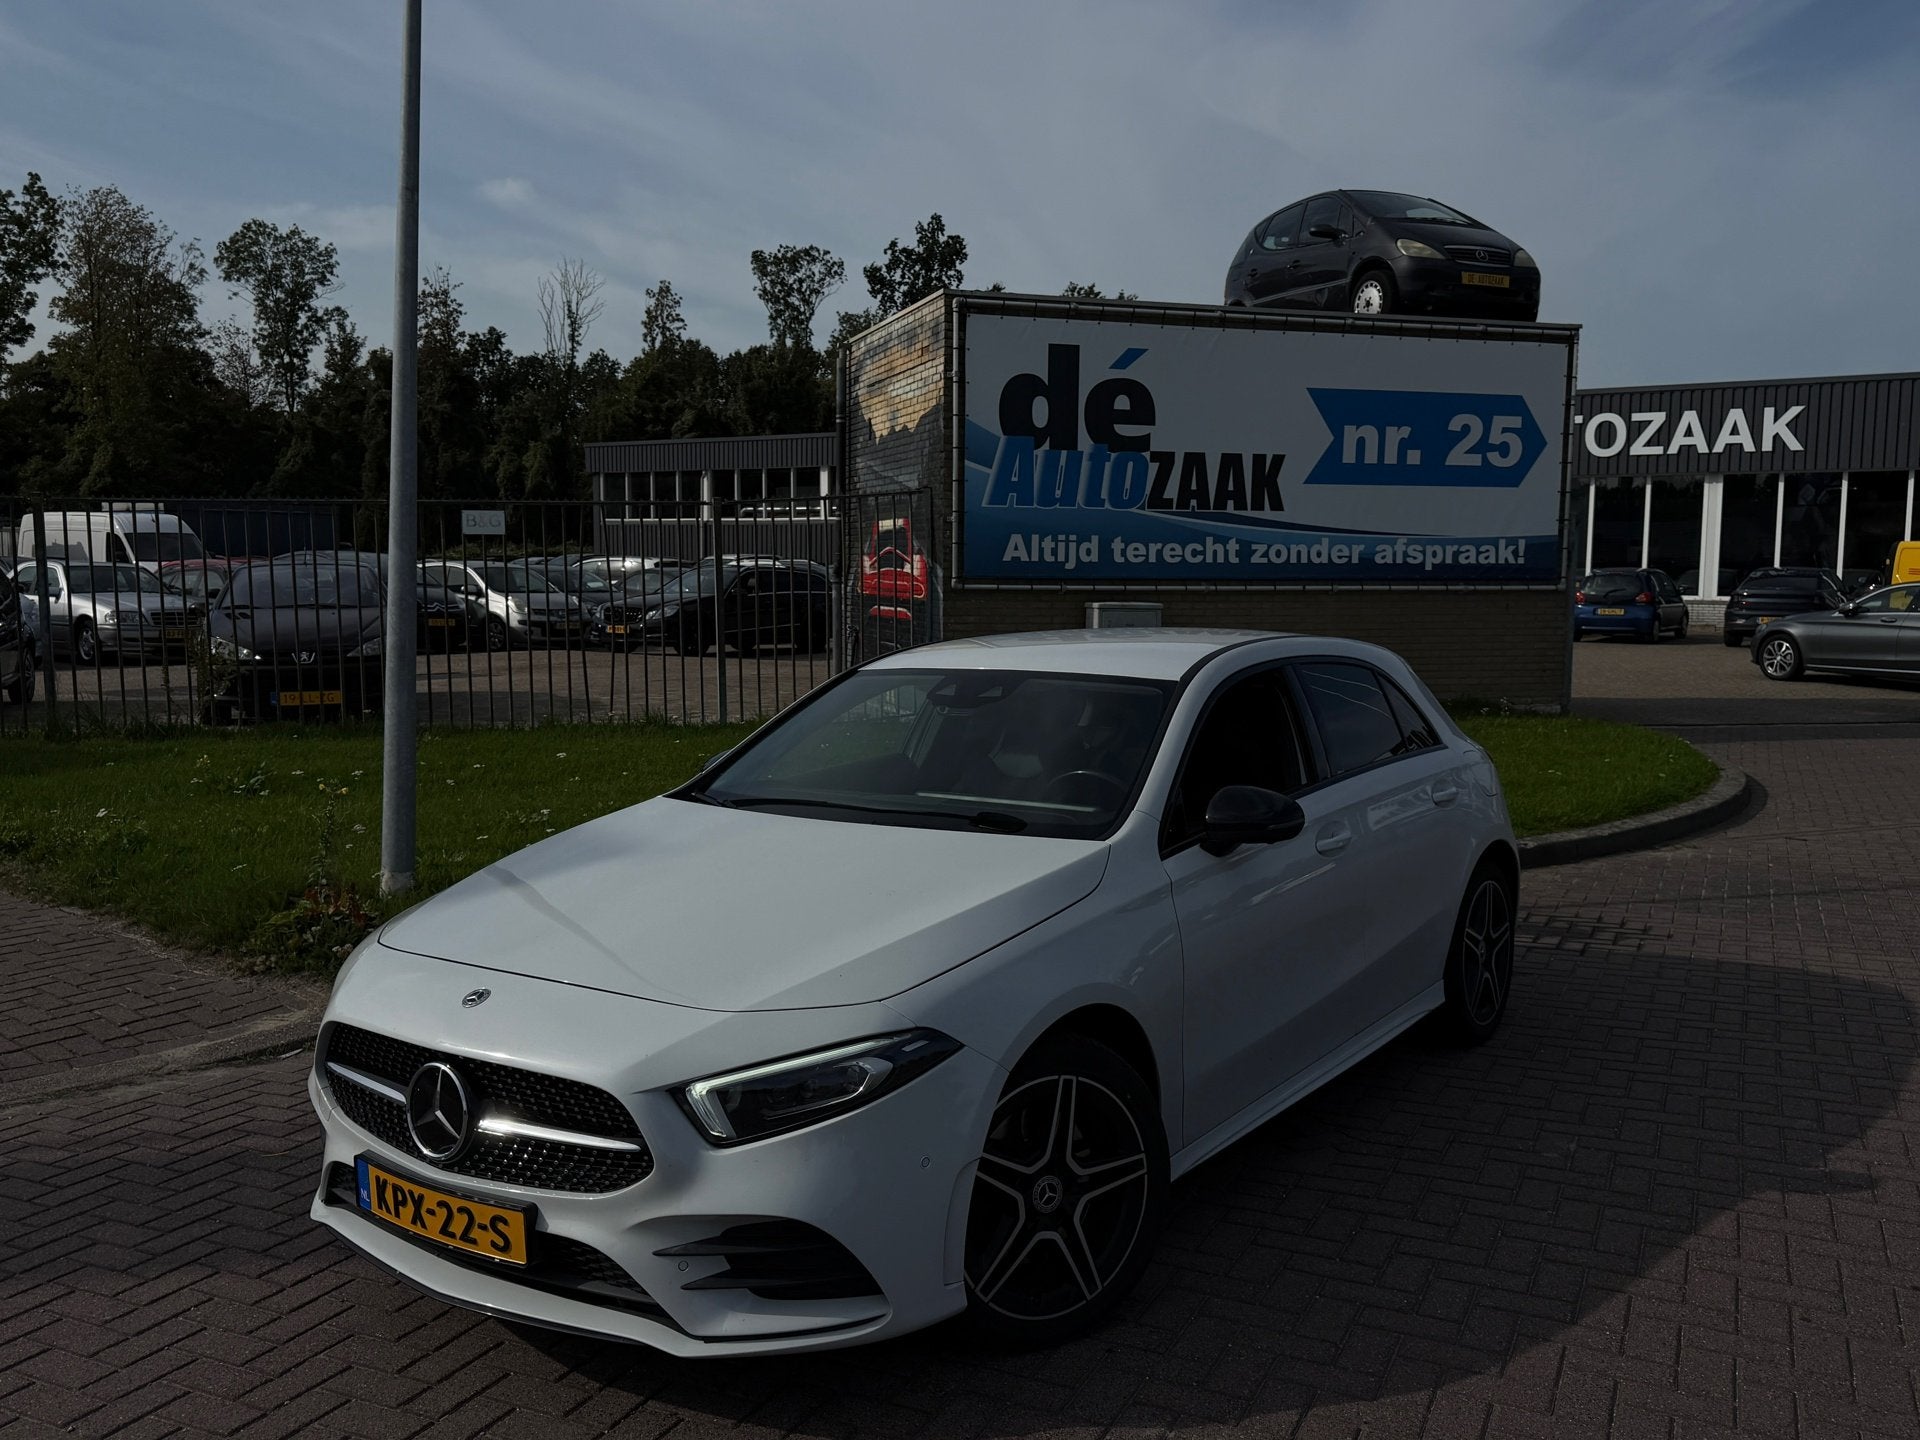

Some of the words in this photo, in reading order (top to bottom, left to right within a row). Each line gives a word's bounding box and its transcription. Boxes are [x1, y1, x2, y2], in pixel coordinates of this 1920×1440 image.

[999, 343, 1156, 453] dé
[1342, 424, 1422, 465] nr.
[1444, 413, 1523, 467] 25
[1574, 405, 1806, 457] OZAAK
[1002, 534, 1099, 570] Altijd
[1111, 536, 1239, 564] terecht
[1250, 538, 1365, 564] zonder
[1374, 538, 1526, 571] afspraak!
[360, 1188, 370, 1201] NL
[375, 1175, 511, 1253] KPX-22-S
